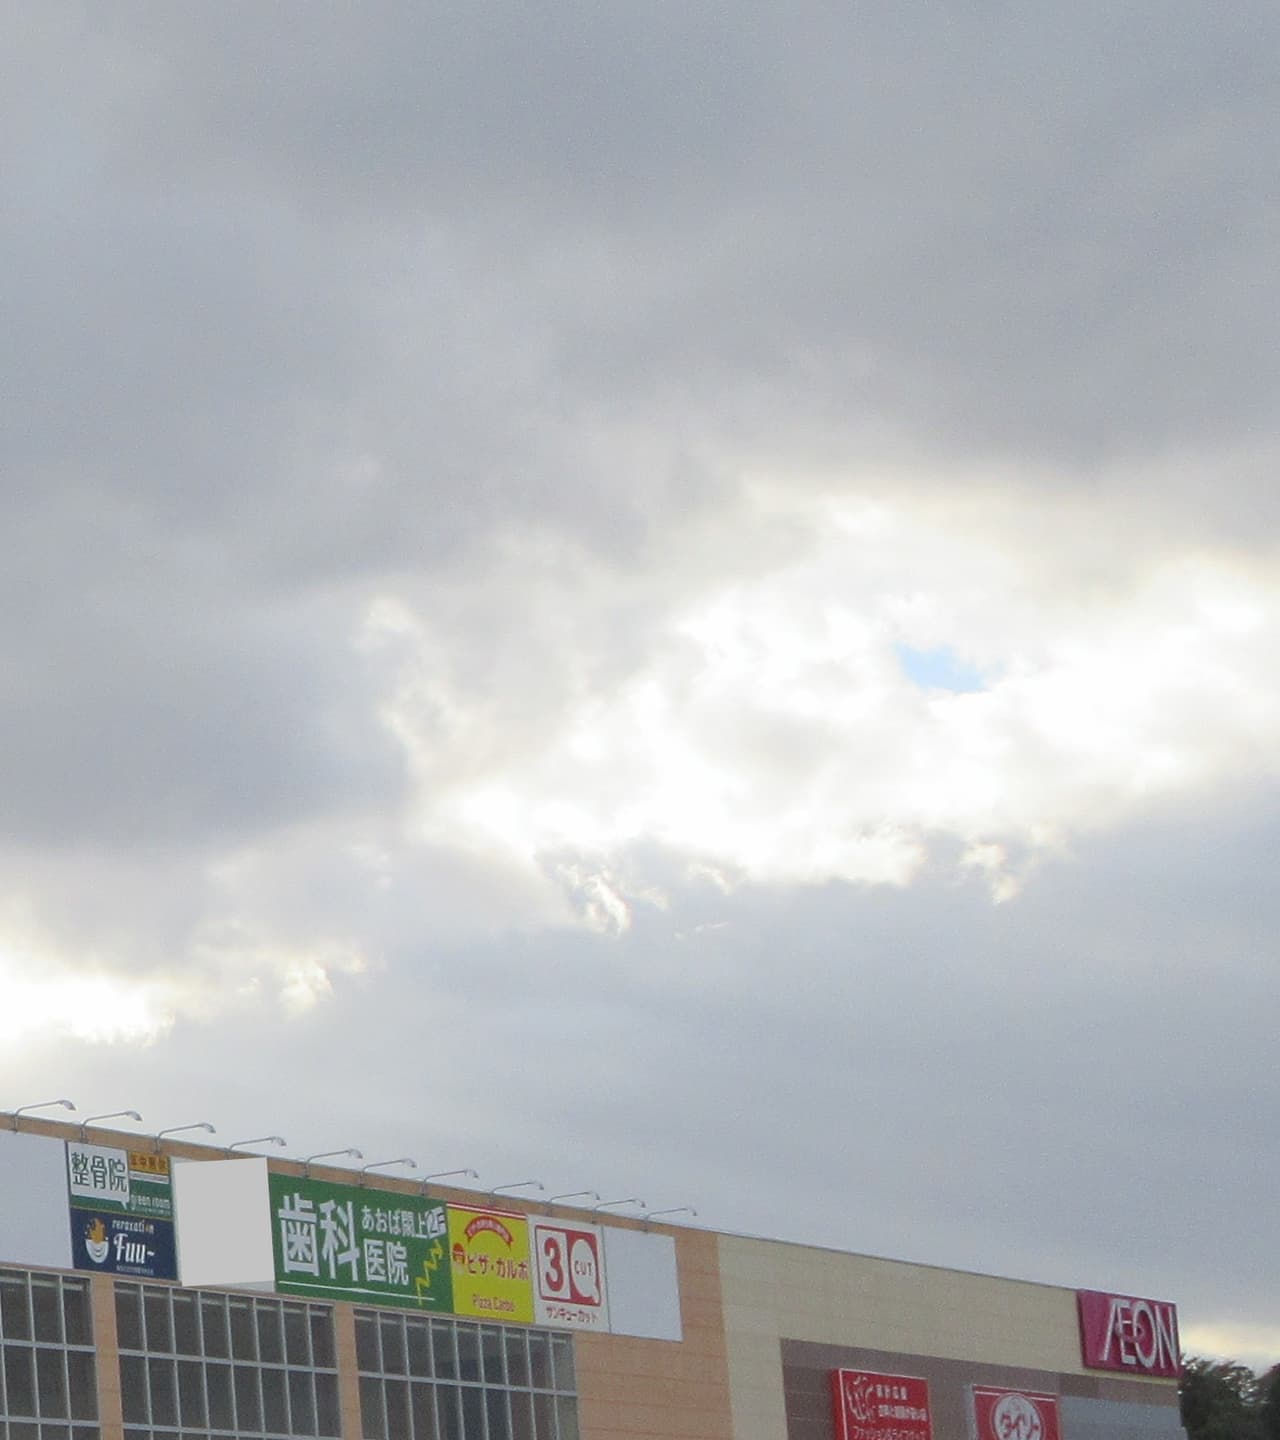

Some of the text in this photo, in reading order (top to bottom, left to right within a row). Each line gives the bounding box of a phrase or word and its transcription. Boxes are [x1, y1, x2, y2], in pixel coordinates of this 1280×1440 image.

[71, 1151, 128, 1193] 整骨院
[277, 1192, 360, 1283] 歯科
[363, 1238, 409, 1286] 医院
[574, 1260, 593, 1276] CUT
[1000, 1408, 1040, 1440] ダイソー
